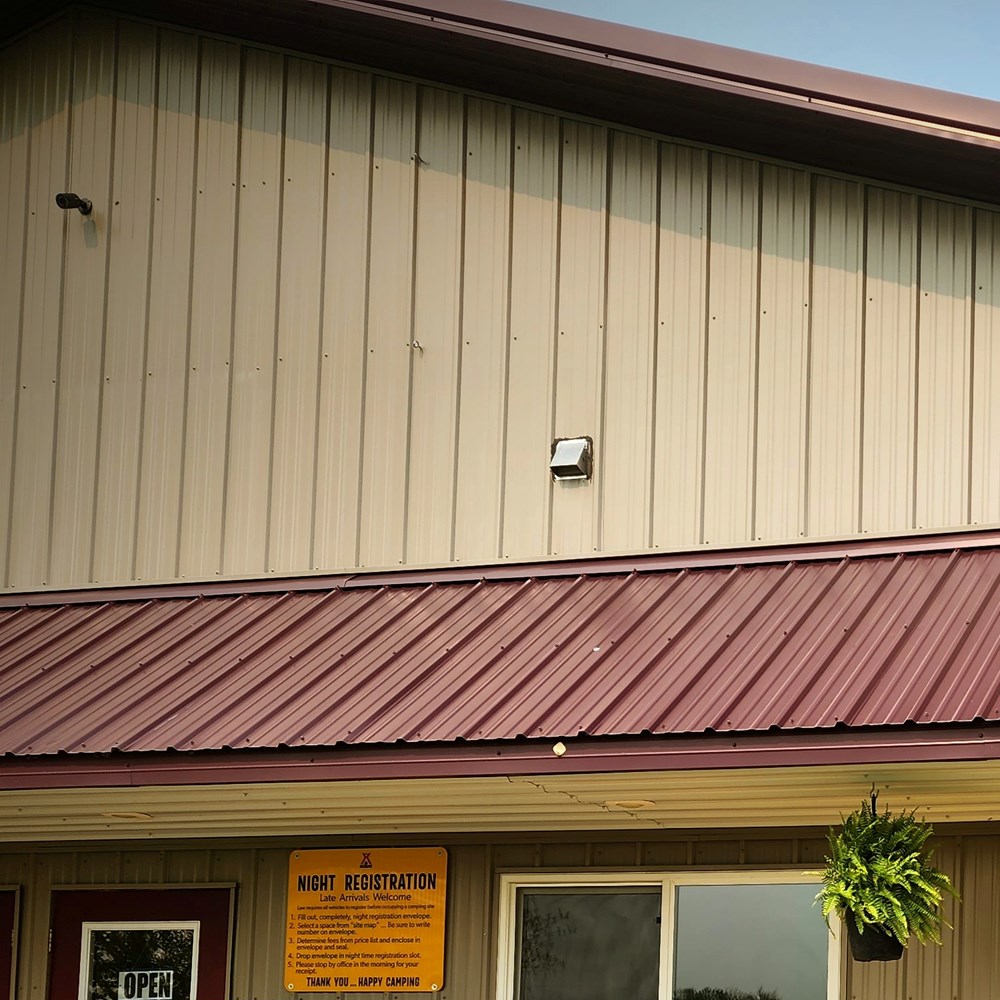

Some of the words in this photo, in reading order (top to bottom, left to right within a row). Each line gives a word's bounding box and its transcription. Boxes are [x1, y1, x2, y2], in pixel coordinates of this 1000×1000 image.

[298, 874, 335, 891] NIGHT
[345, 873, 436, 891] REGISTRATION
[340, 893, 369, 901] Arrivals
[373, 893, 411, 901] Welcome
[369, 913, 402, 921] registration
[354, 937, 369, 945] price
[345, 952, 360, 960] night
[375, 952, 408, 960] registration
[124, 972, 172, 998] OPEN
[307, 977, 330, 987] THANK
[334, 977, 348, 987] YOU
[358, 977, 382, 987] HAPPY
[386, 977, 420, 987] CAMPING
